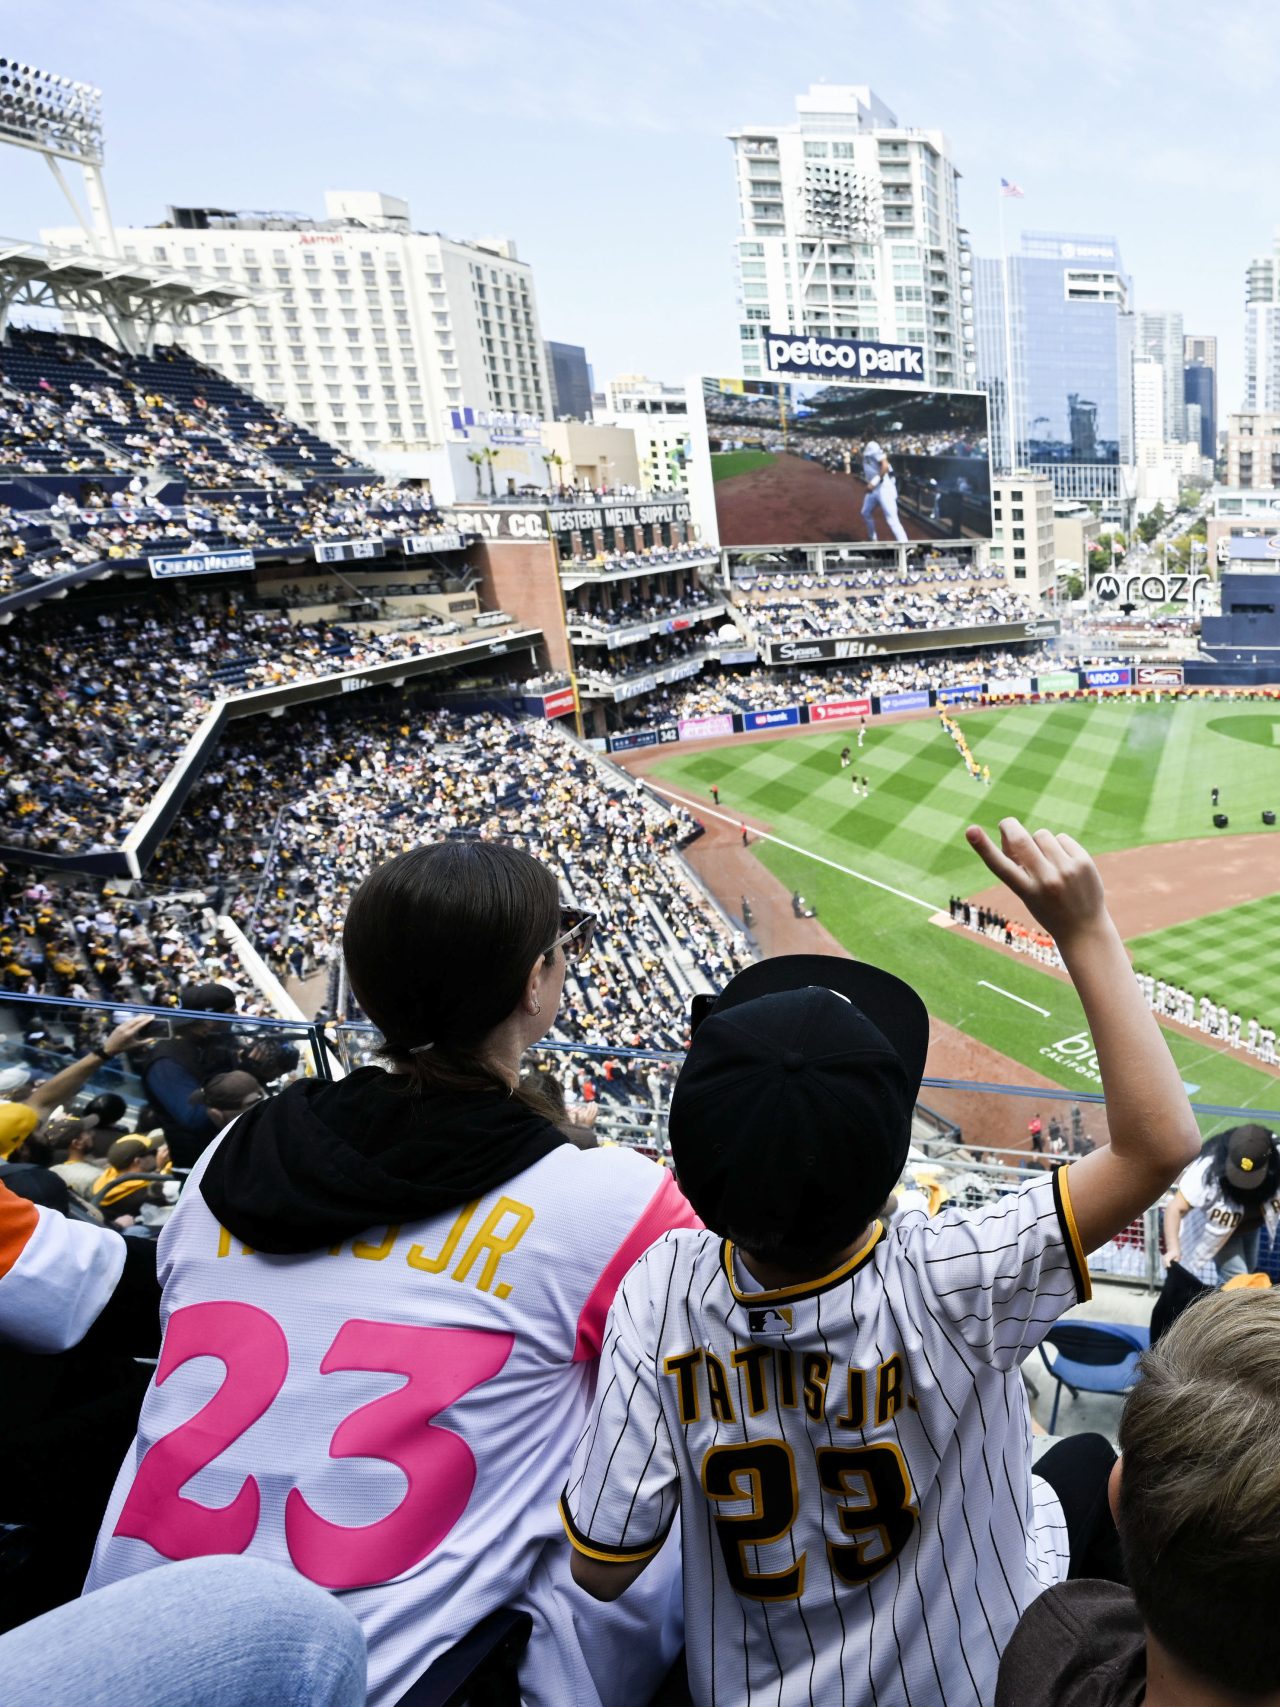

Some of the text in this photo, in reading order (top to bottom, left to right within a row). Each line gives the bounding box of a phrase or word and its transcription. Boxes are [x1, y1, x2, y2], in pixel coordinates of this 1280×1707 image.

[768, 338, 923, 376] petco park
[508, 514, 549, 538] CO.
[551, 509, 602, 531] WESTERN
[605, 507, 639, 527] METAL
[640, 505, 674, 524] SUPPLY
[1127, 576, 1210, 601] razr
[1089, 672, 1119, 684] ARCO
[660, 729, 677, 741] 342
[406, 1195, 535, 1300] JR.
[664, 1345, 919, 1431] TATIS JR.
[113, 1300, 515, 1590] 23
[701, 1438, 920, 1602] 23
